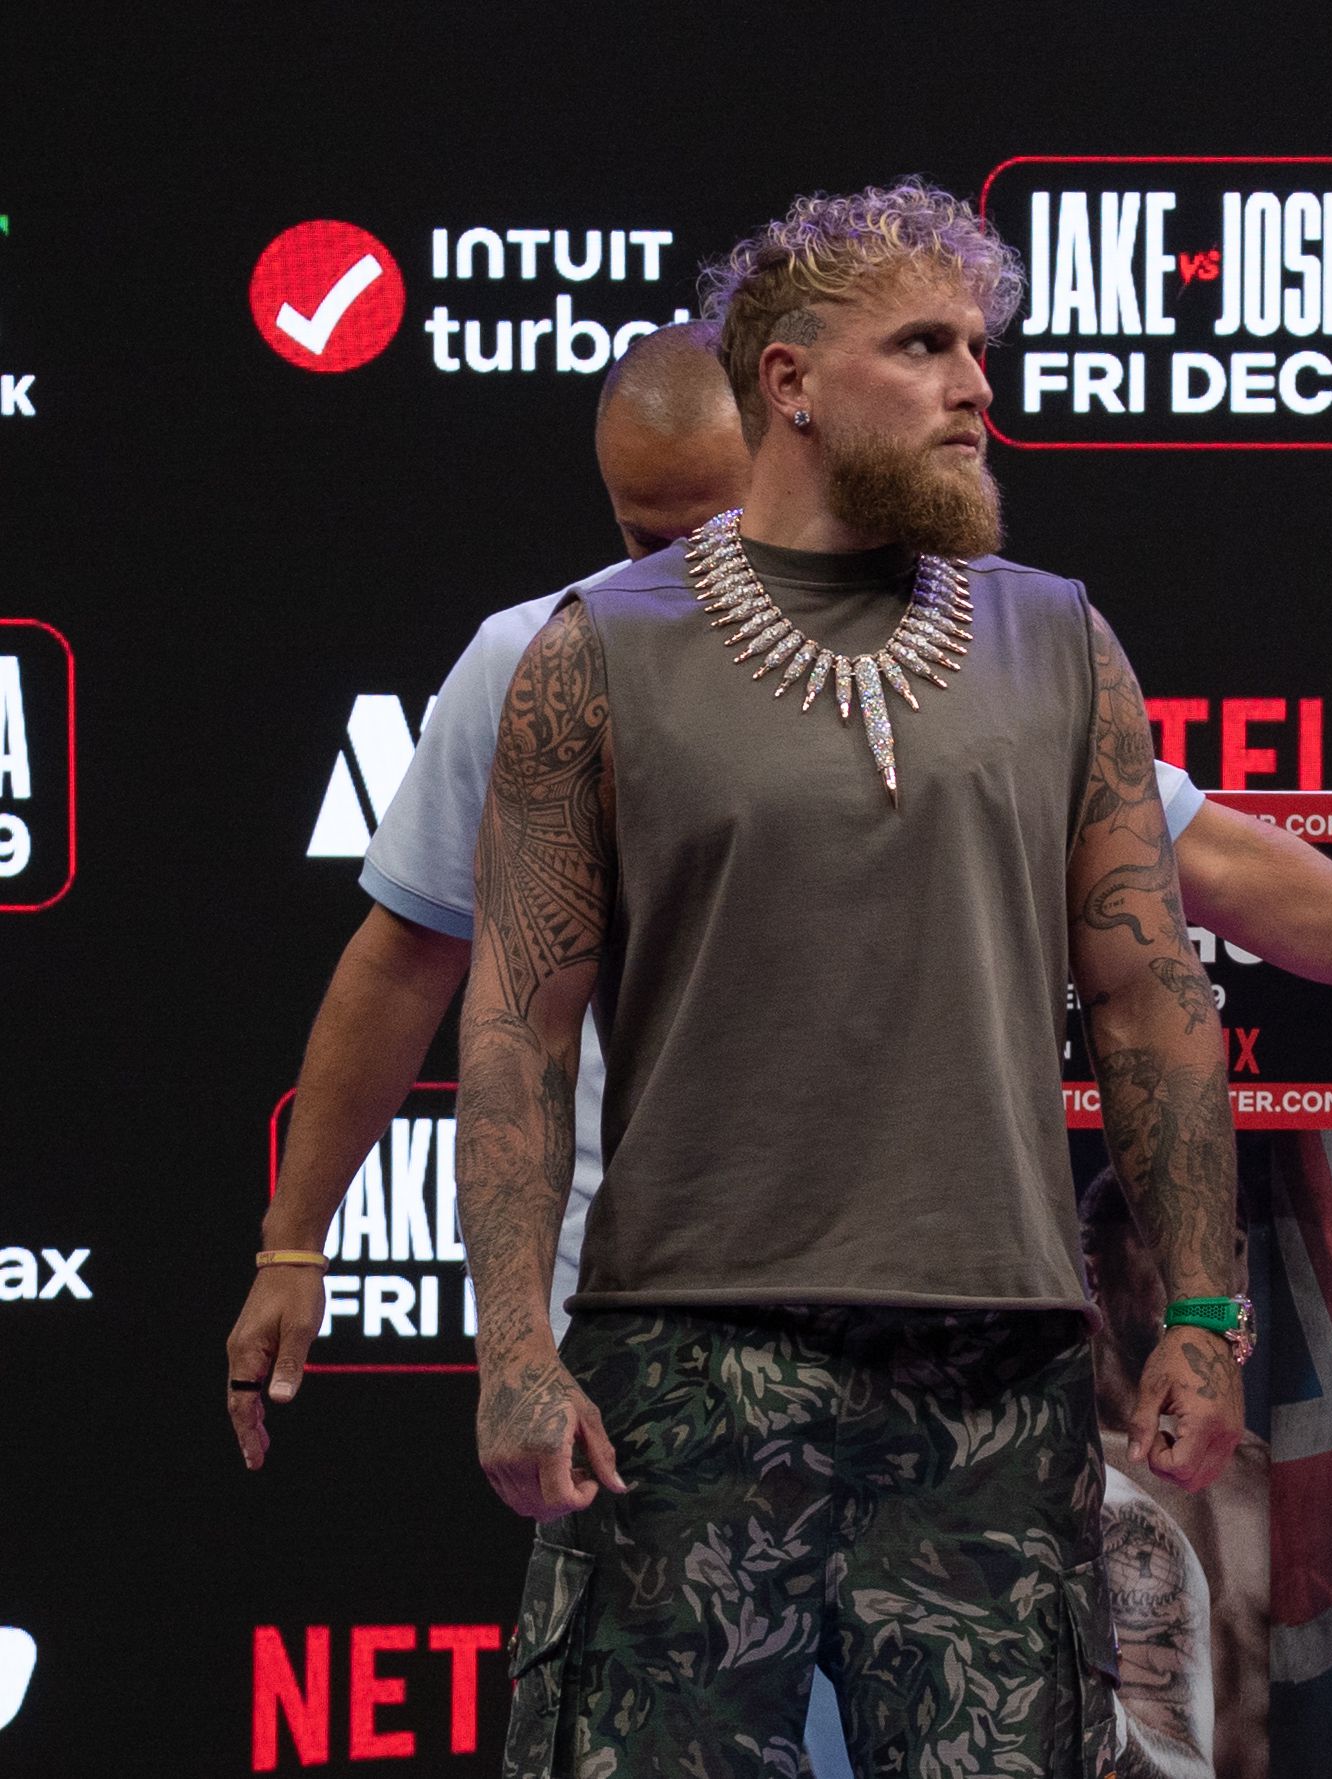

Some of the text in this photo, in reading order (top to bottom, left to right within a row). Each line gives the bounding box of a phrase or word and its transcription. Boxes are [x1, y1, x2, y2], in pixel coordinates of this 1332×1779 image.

[1022, 192, 1176, 336] JAKE
[1024, 352, 1146, 413] FRI
[318, 1275, 439, 1337] FRI
